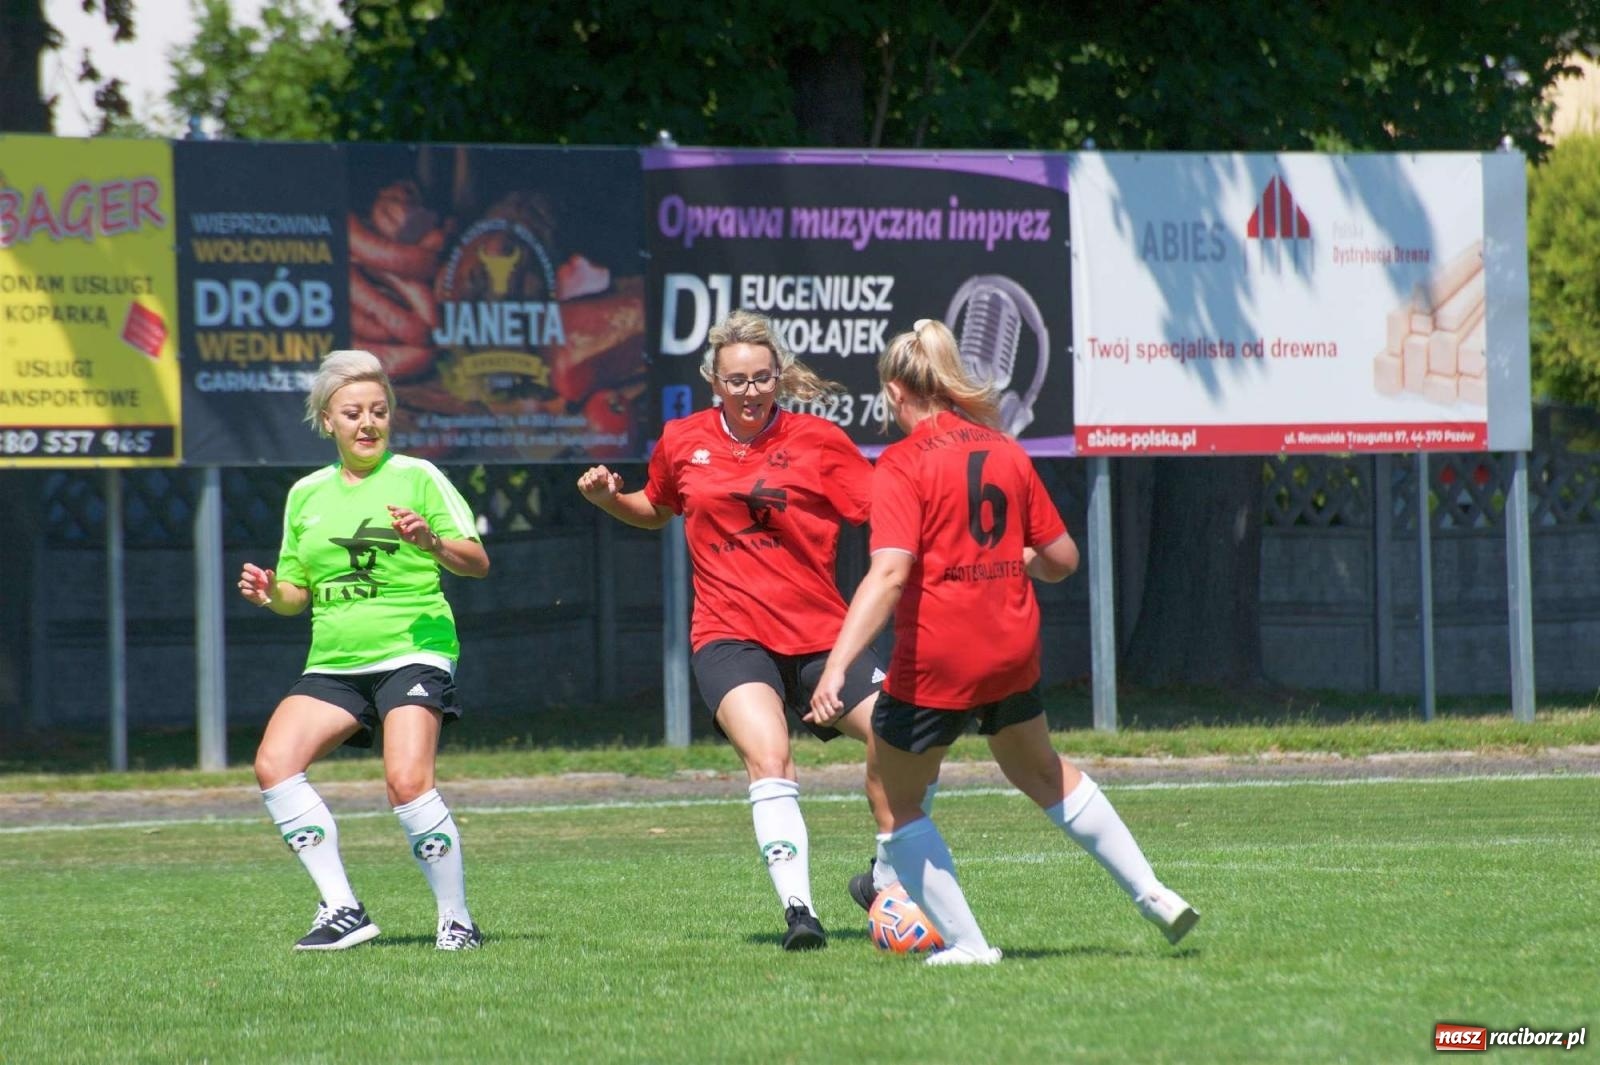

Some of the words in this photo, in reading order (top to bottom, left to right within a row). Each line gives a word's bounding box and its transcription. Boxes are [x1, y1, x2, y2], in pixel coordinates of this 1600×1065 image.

[191, 213, 333, 235] WIEPRZOWINA
[658, 194, 783, 248] Oprawa
[791, 205, 943, 250] muzyczna
[949, 195, 1051, 251] imprez
[1142, 220, 1226, 262] ABIES
[193, 266, 334, 327] DRÓB
[740, 274, 894, 311] EUGENIUSZ
[432, 302, 566, 346] JANETA
[196, 331, 334, 368] WĘDLINY
[1088, 337, 1129, 363] Twój
[1136, 338, 1235, 364] specjalista
[1241, 339, 1264, 358] od
[1270, 338, 1338, 358] drewna
[858, 393, 896, 427] 76
[0, 430, 39, 453] 80
[43, 430, 95, 453] 557
[102, 430, 154, 453] 965
[1088, 428, 1197, 450] abies-polska.pl
[1298, 432, 1345, 445] Romualda
[966, 450, 1009, 549] 6
